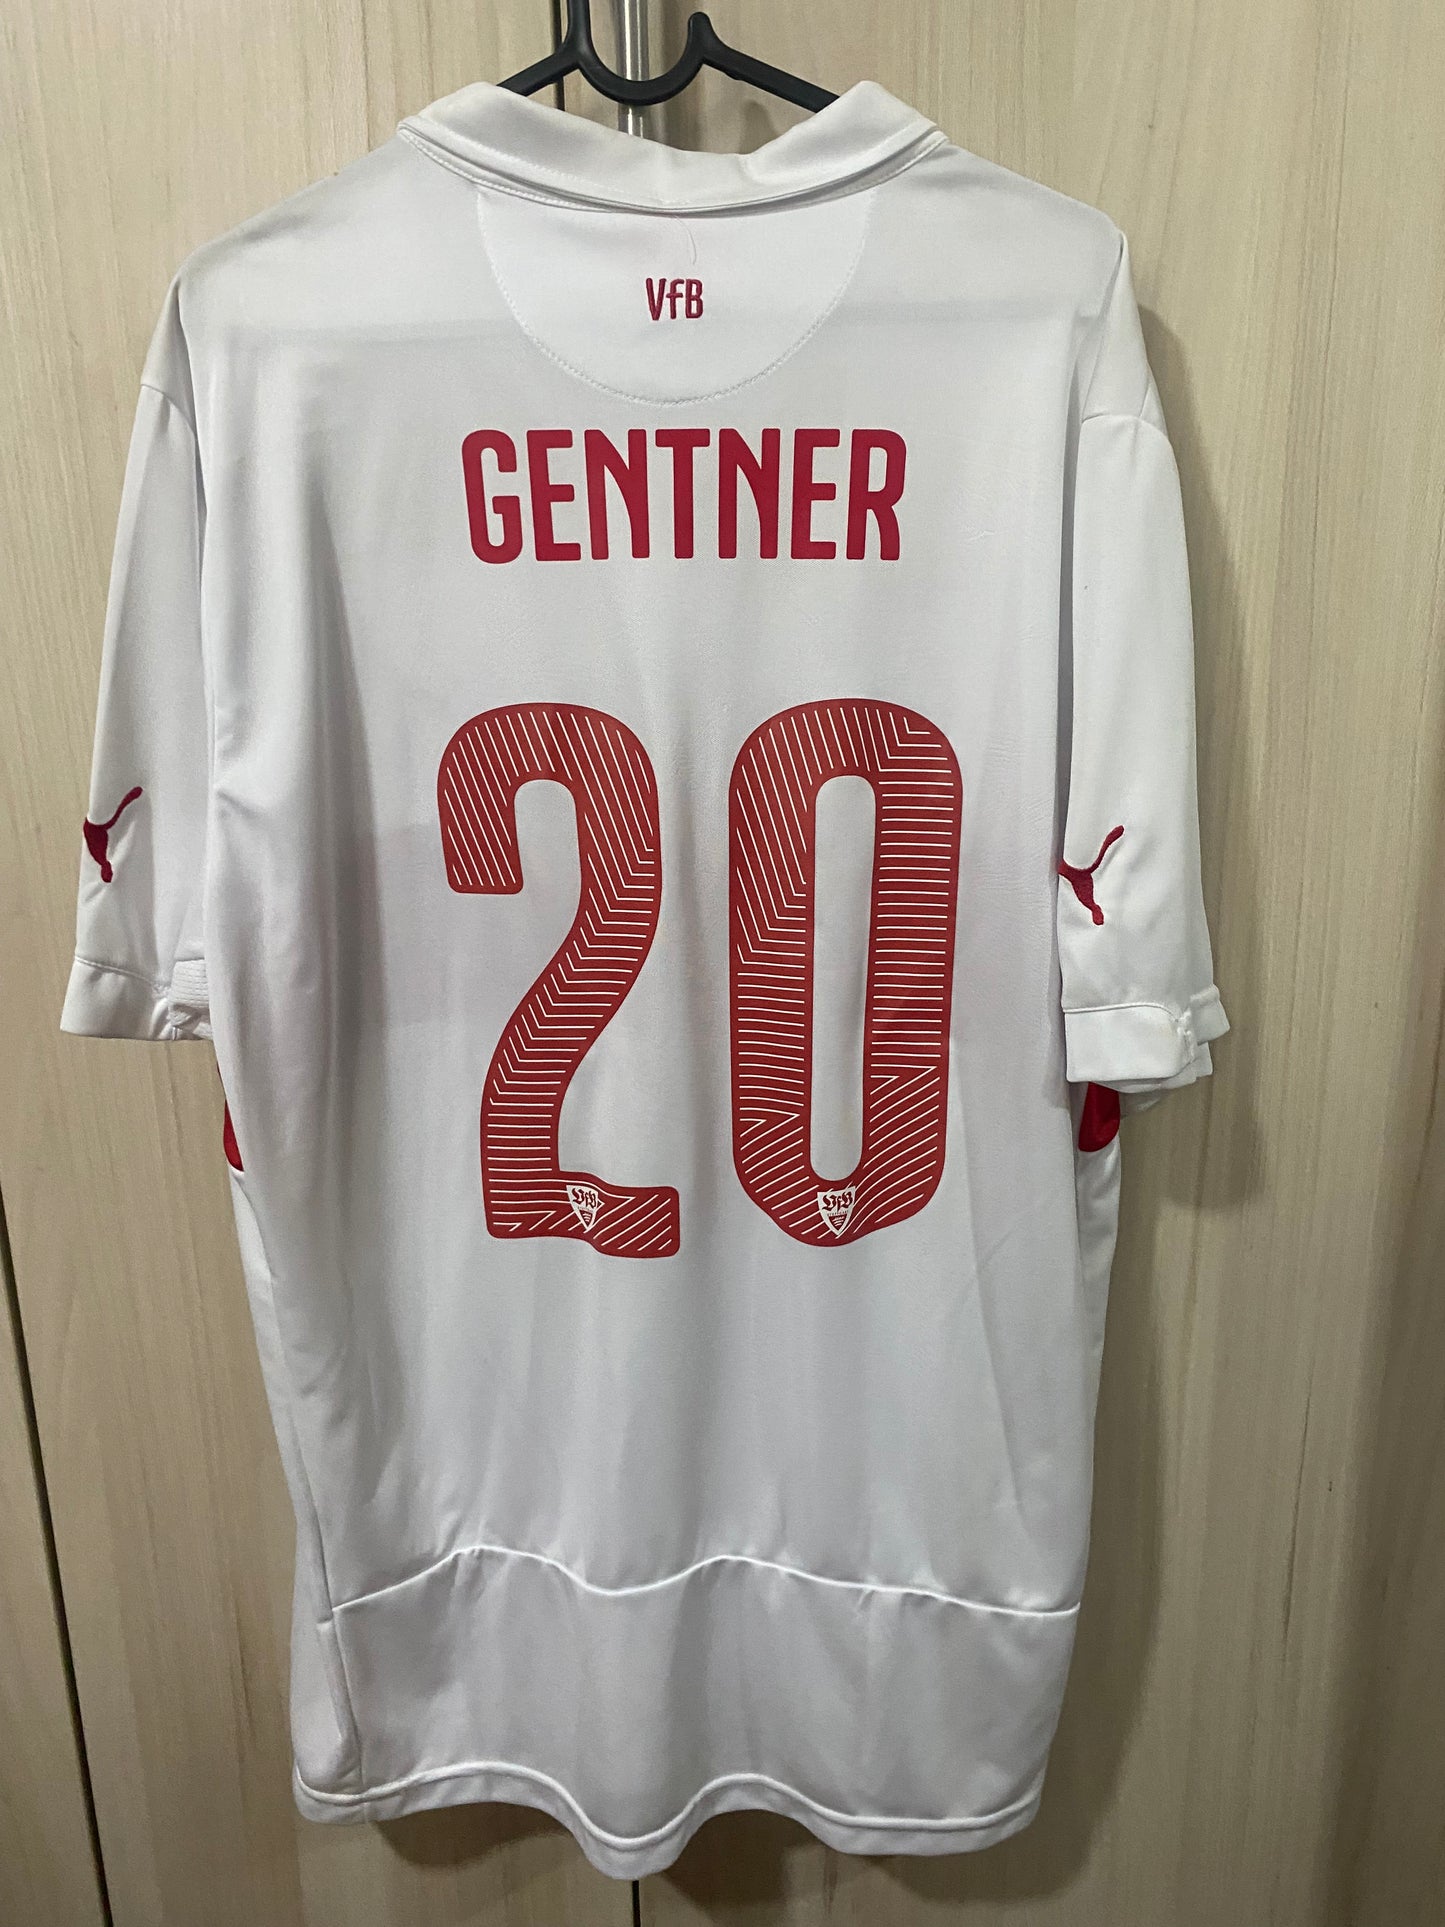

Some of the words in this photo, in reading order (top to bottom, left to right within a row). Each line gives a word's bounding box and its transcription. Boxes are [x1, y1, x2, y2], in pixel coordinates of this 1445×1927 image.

[646, 278, 704, 322] VfB
[462, 428, 908, 565] GENTNER
[437, 699, 964, 1260] 20
